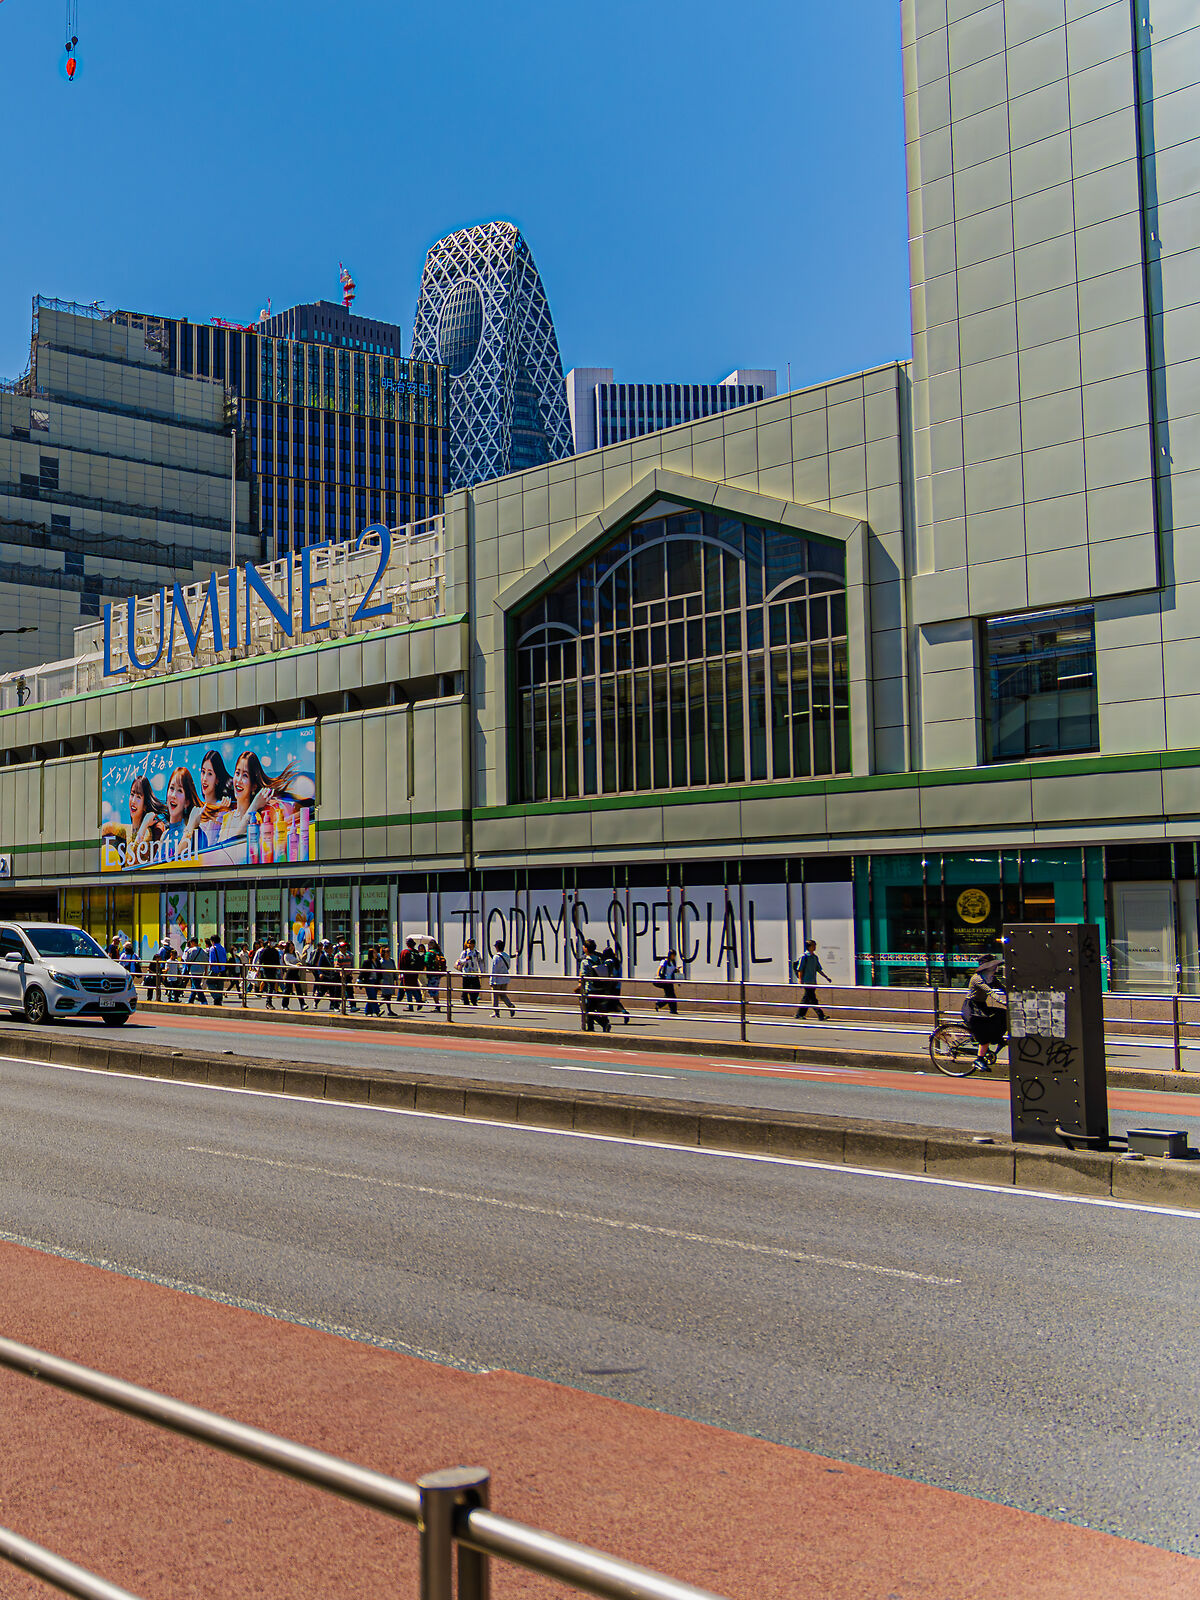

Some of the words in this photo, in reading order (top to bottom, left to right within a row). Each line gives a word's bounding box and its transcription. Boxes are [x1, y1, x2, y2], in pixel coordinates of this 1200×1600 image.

[381, 377, 430, 397] 明治安田
[104, 539, 333, 678] LUMINE
[351, 523, 394, 623] 2
[104, 829, 199, 867] Essential
[450, 894, 590, 964] TODAY'S
[606, 900, 774, 968] SPECIAL
